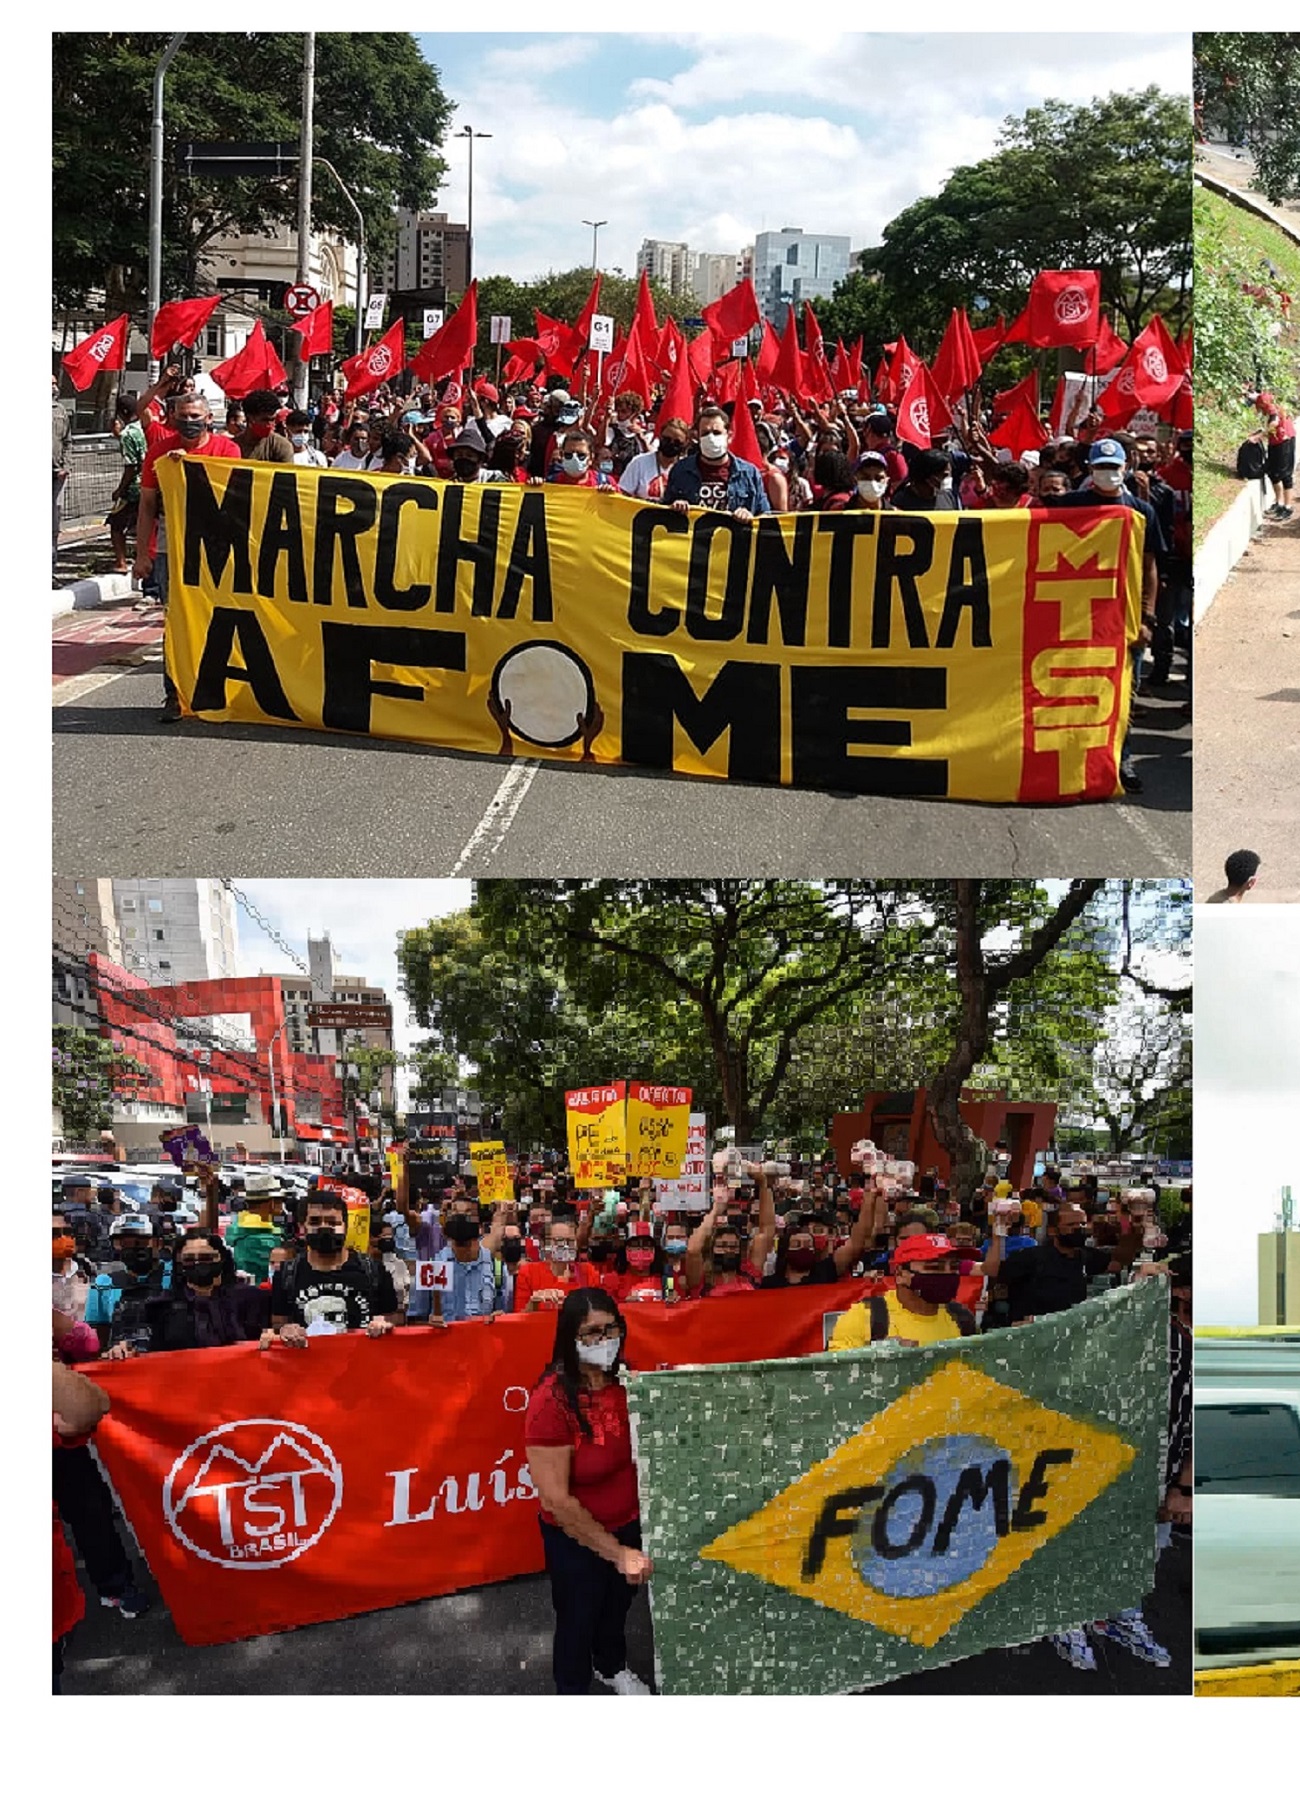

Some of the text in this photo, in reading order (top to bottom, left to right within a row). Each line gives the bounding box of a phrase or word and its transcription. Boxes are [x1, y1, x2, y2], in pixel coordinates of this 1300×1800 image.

[593, 321, 610, 333] G1
[183, 461, 992, 649] MARCHA CONTRA
[191, 606, 302, 722] A
[1029, 517, 1126, 796] MTST
[420, 1264, 448, 1289] G4
[229, 1531, 308, 1559] BRASIL
[799, 1446, 1075, 1585] FOME
